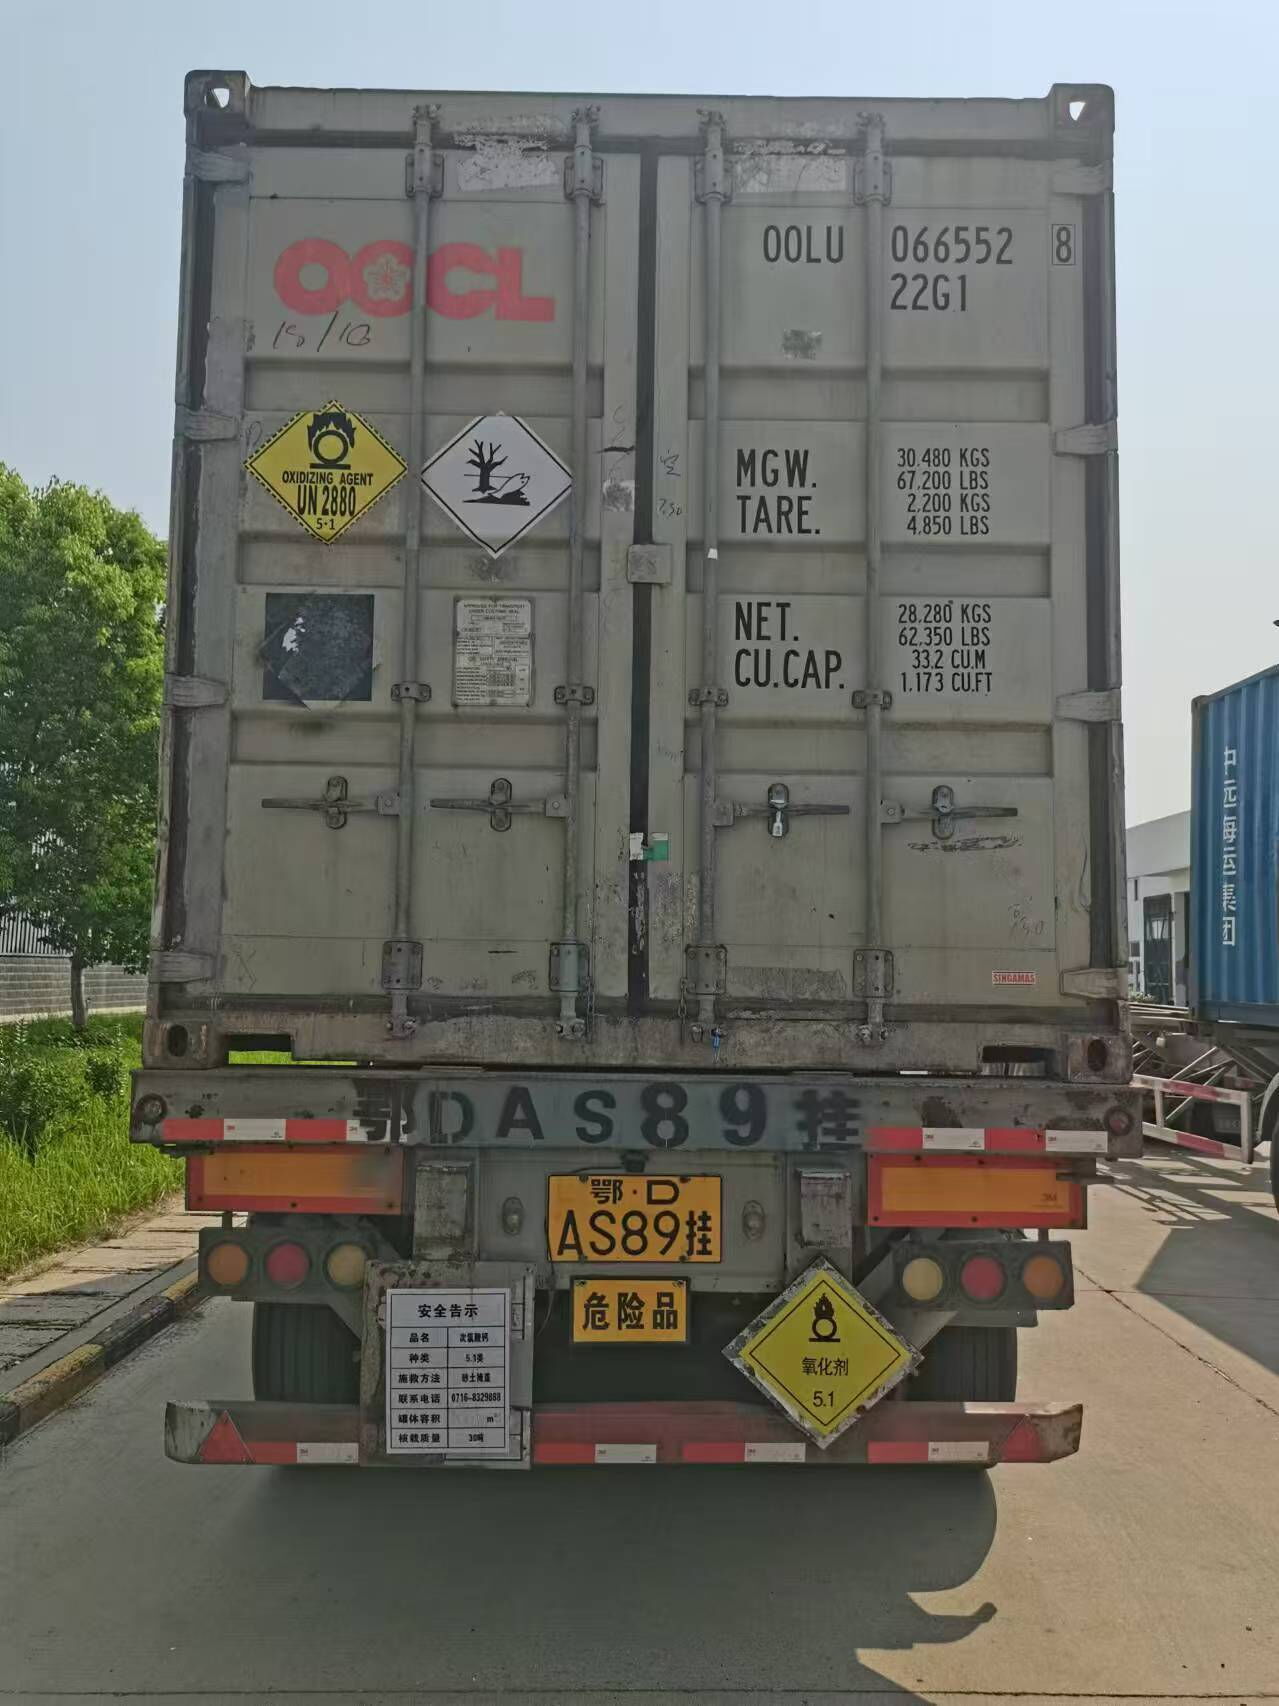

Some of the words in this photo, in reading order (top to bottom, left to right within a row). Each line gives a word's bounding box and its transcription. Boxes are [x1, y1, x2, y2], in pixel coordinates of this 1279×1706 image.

[763, 225, 844, 263] OOLU
[891, 226, 1013, 264] 066552
[1055, 228, 1072, 261] 8
[275, 239, 555, 321] OOCL
[890, 274, 967, 311] 22G1
[960, 449, 990, 467] KGS
[282, 471, 334, 485] OXIDIZING
[339, 472, 373, 486] AGENT
[736, 449, 817, 488] MGW.
[897, 471, 951, 490] 67,200
[960, 471, 988, 490] LBS
[298, 486, 316, 516] UN
[322, 486, 356, 516] 2880
[908, 494, 951, 513] 2,200
[960, 494, 990, 512] KGS
[736, 496, 820, 535] TARE.
[960, 516, 989, 535] LBS
[735, 602, 798, 641] NET.
[961, 603, 991, 624] KGS
[898, 627, 952, 647] 62,350
[961, 627, 990, 646] LBS
[734, 649, 844, 688] CU.CAP.
[912, 650, 943, 669] 33.2
[951, 650, 985, 669] CU.M
[952, 673, 991, 693] CU.FT
[557, 1209, 712, 1257] AS89挂
[418, 1304, 478, 1318] 安全告示
[582, 1292, 678, 1330] 危险品
[410, 1333, 429, 1343] 品名
[409, 1353, 429, 1363] 种类
[802, 1357, 849, 1377] 氧化剂
[398, 1374, 440, 1383] 施救方法
[398, 1394, 440, 1403] 联系电话
[813, 1390, 834, 1407] 5.1
[398, 1414, 440, 1424] 罐体容积
